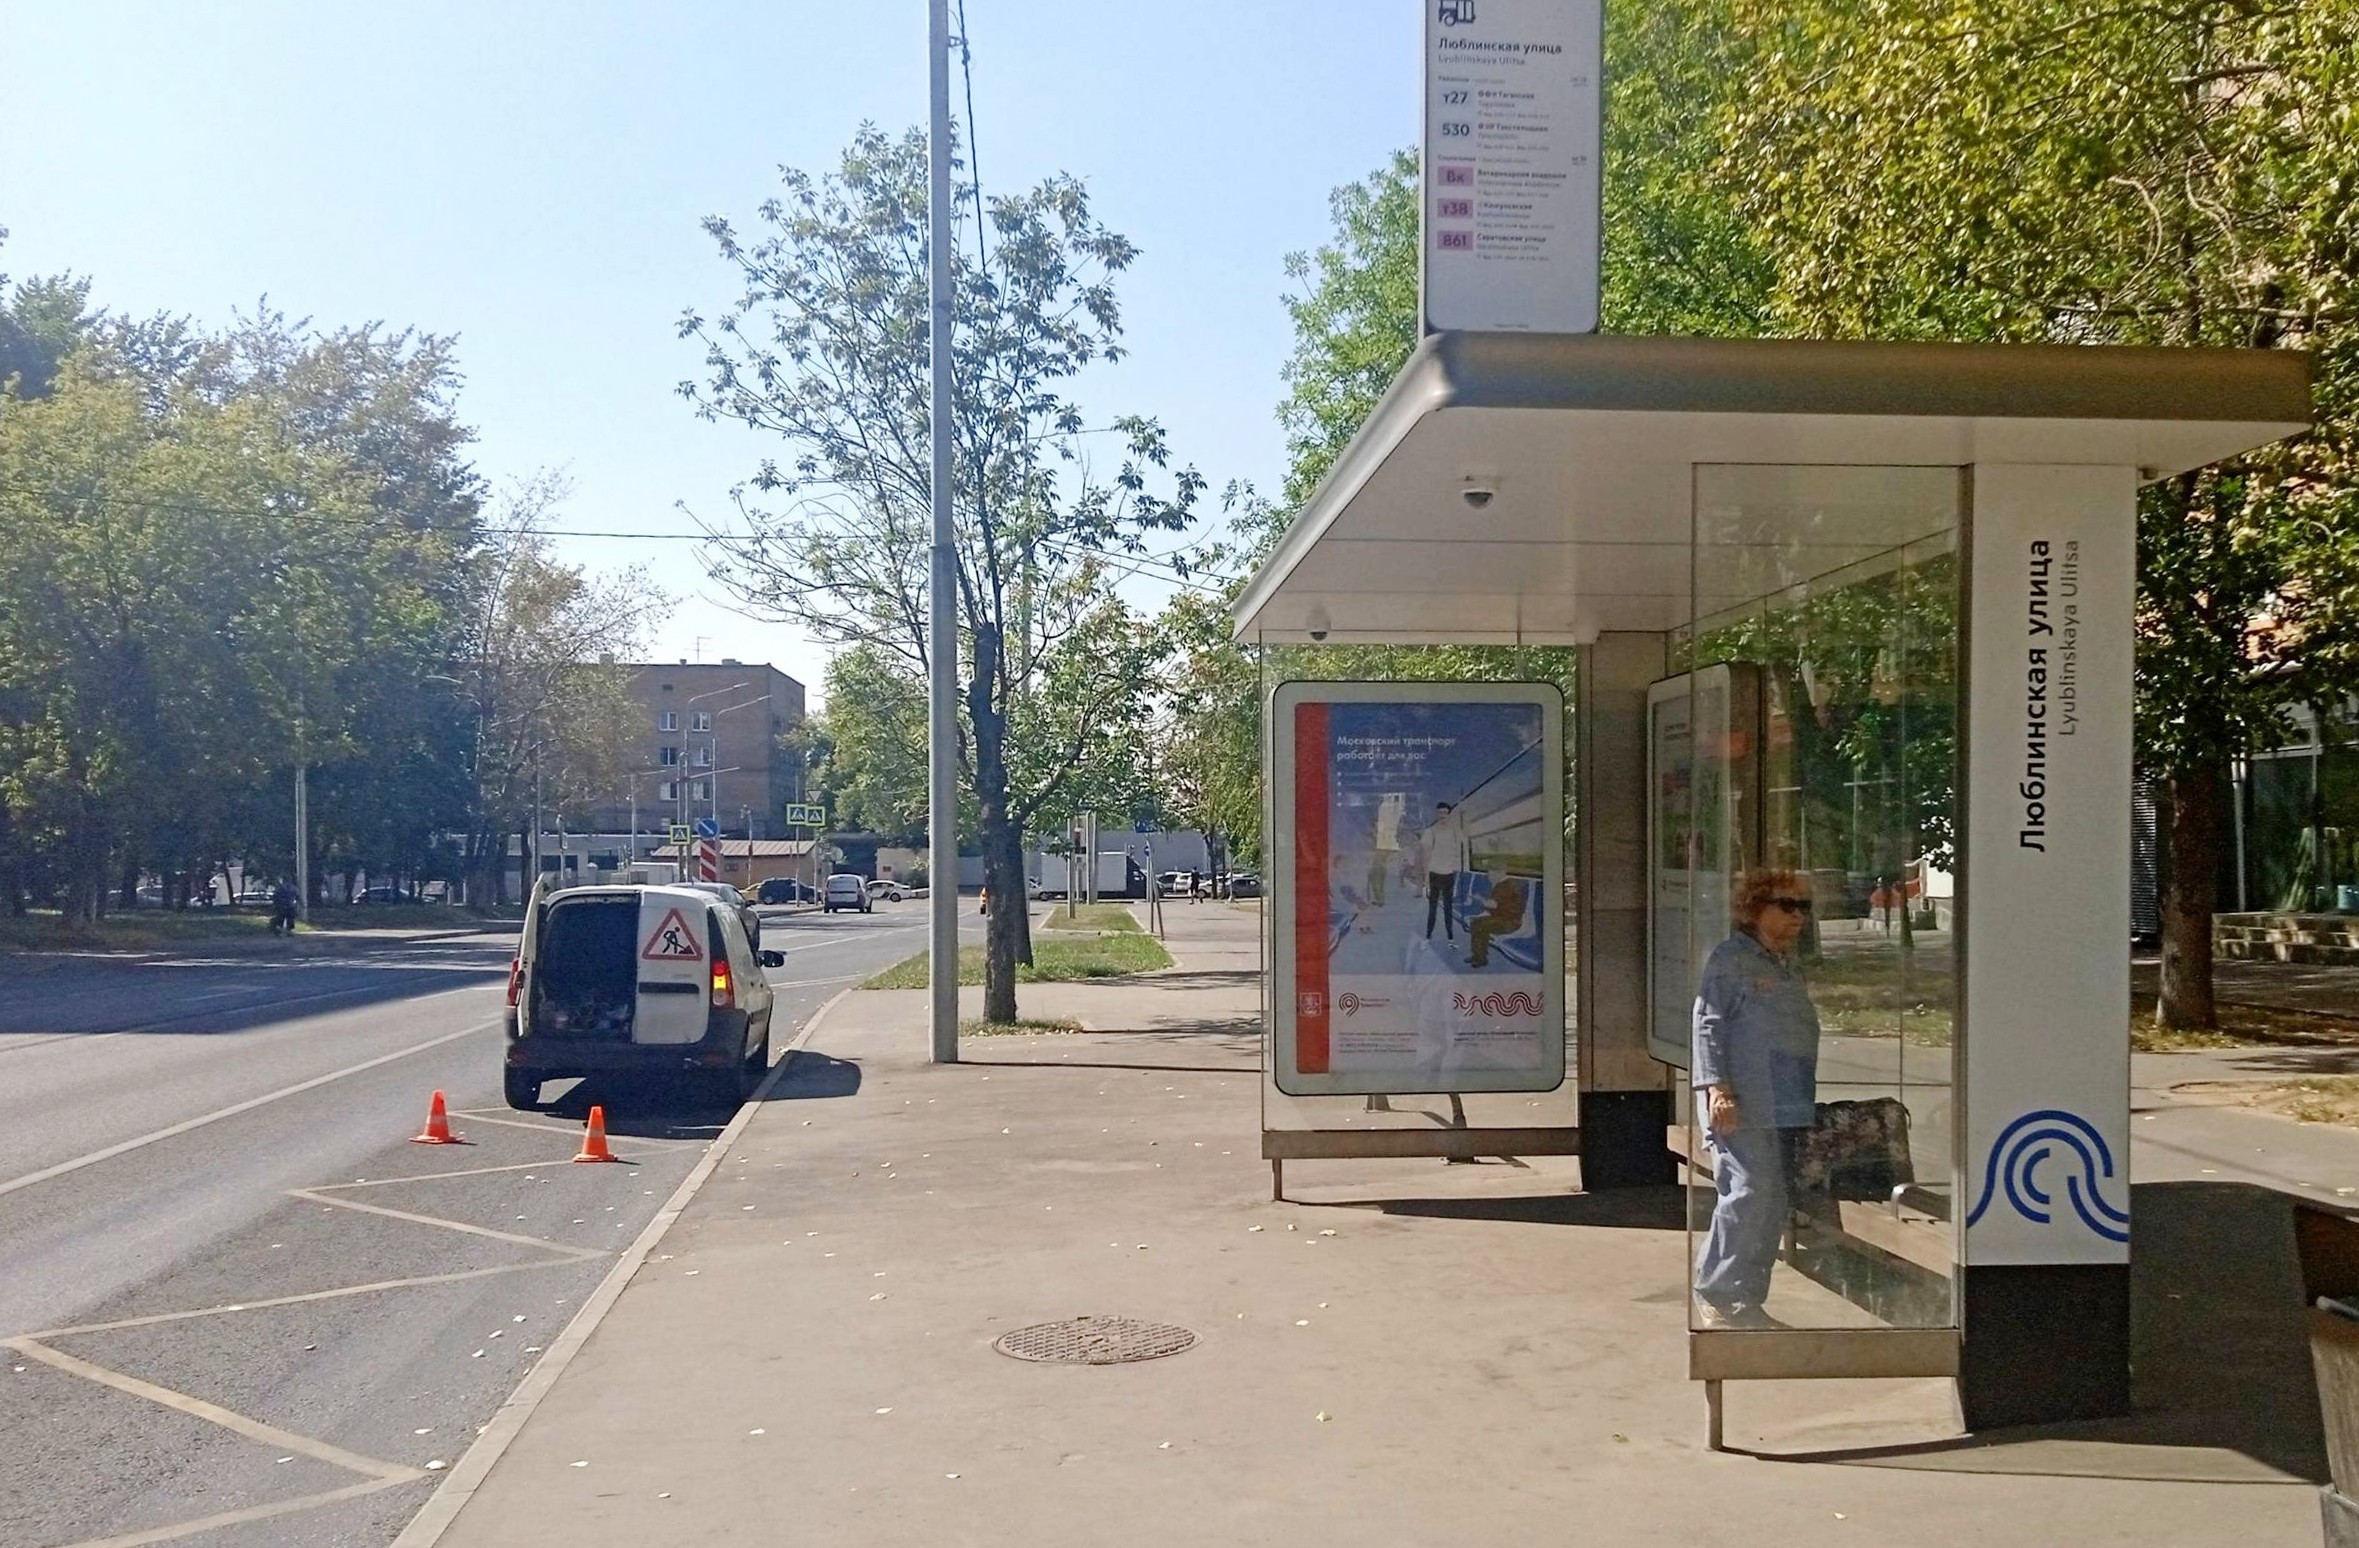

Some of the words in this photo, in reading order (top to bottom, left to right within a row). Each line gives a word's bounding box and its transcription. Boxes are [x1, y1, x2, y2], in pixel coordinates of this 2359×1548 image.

[1439, 38, 1520, 51] Люблинская
[1523, 44, 1562, 55] улица
[1442, 123, 1470, 136] 530
[1443, 234, 1466, 247] 861
[2059, 540, 2079, 597] Ulitsa
[2028, 540, 2053, 636] улица
[2058, 604, 2080, 735] Lyublinskaya
[1337, 735, 1400, 746] Московский
[2019, 648, 2048, 852] Люблинская
